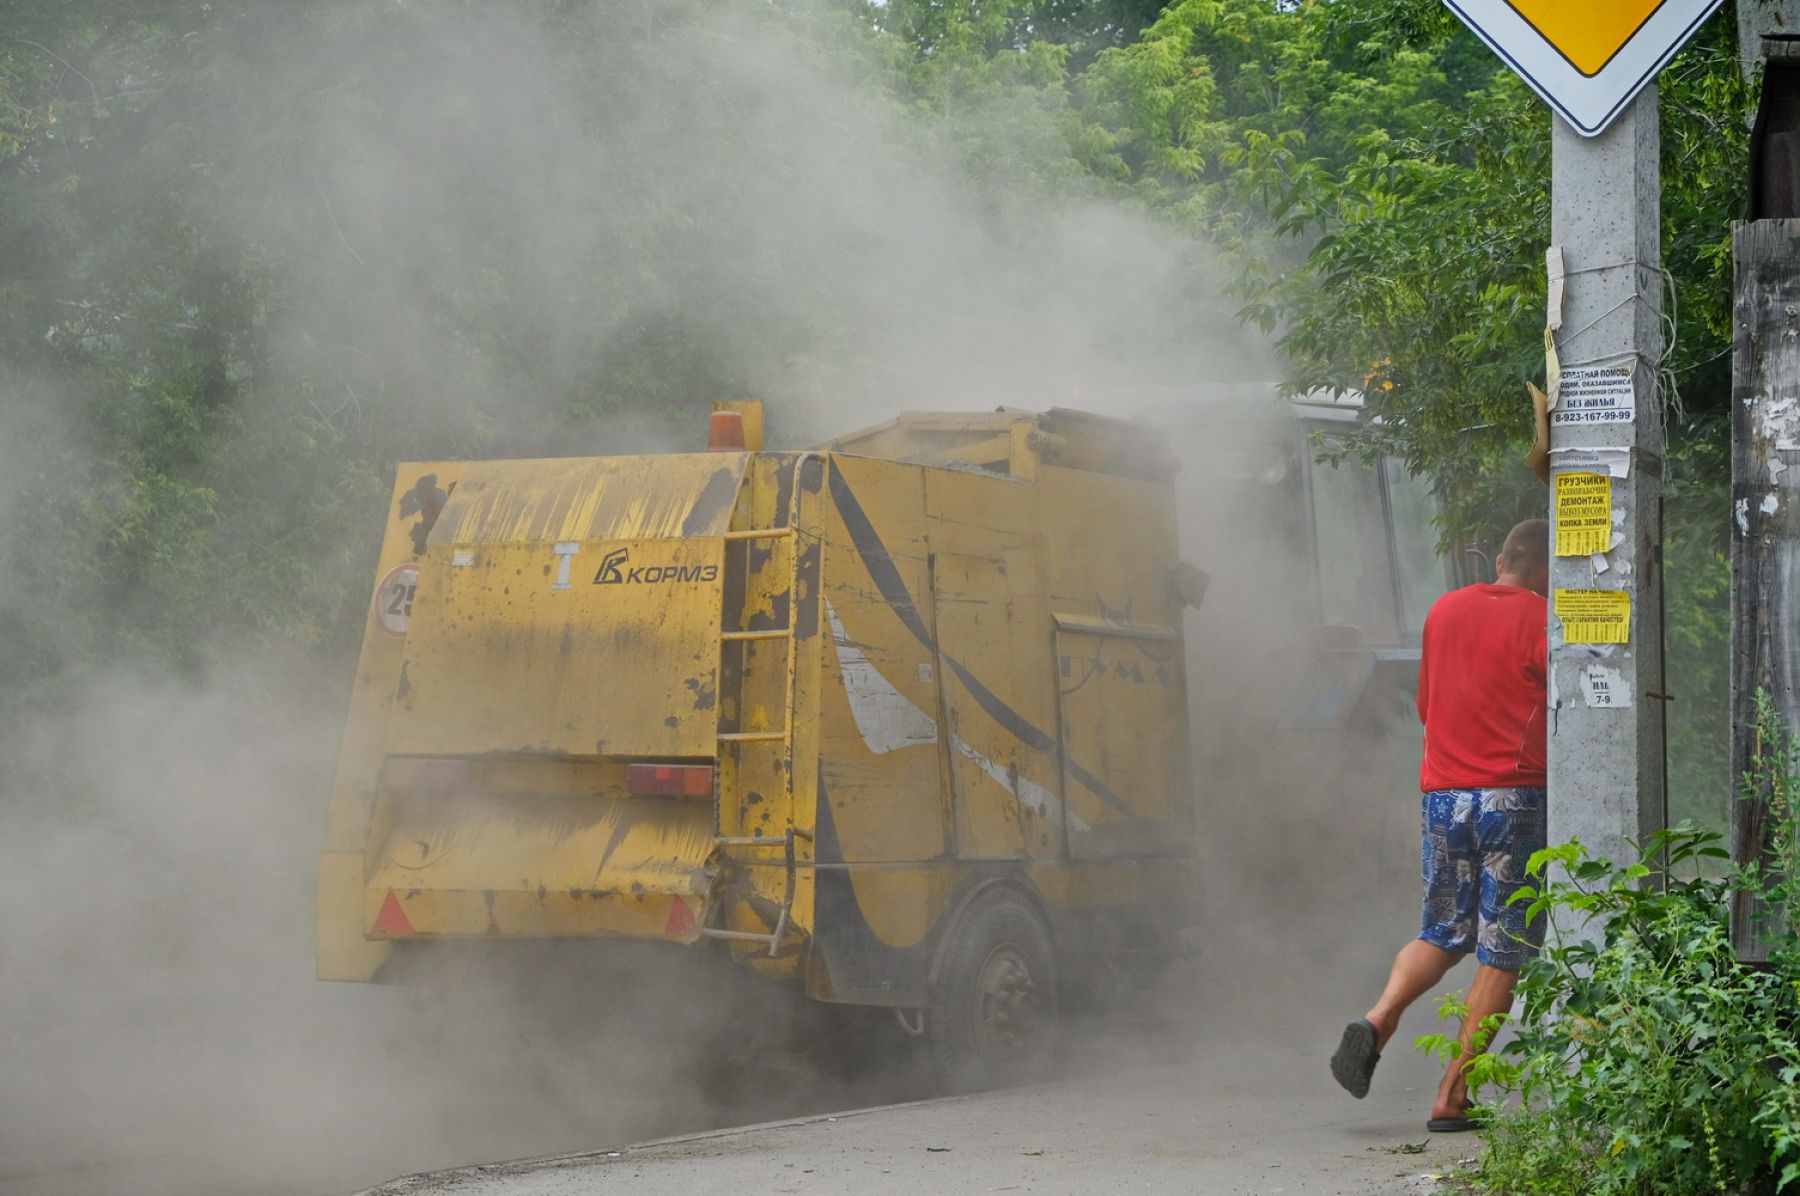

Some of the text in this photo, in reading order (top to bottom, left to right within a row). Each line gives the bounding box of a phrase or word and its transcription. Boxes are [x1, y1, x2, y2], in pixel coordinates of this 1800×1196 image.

[1562, 370, 1599, 379] СПЛАТНАЯ
[1584, 398, 1615, 407] ЖИЛЬЯ
[1555, 410, 1631, 422] 8-923-167-99-99
[1558, 476, 1605, 487] ГРУЗЧИКИ
[1557, 486, 1607, 495] РАЗНОРАБОЧИЕ
[1560, 496, 1605, 507] ДЕМОНТАЖ
[1559, 506, 1607, 516] ВЫВОЗ МУСОРА
[1560, 518, 1607, 527] КОПКА ЗЕМЛИ
[626, 565, 719, 584] КОРМЗ
[1596, 695, 1612, 704] 7-9
